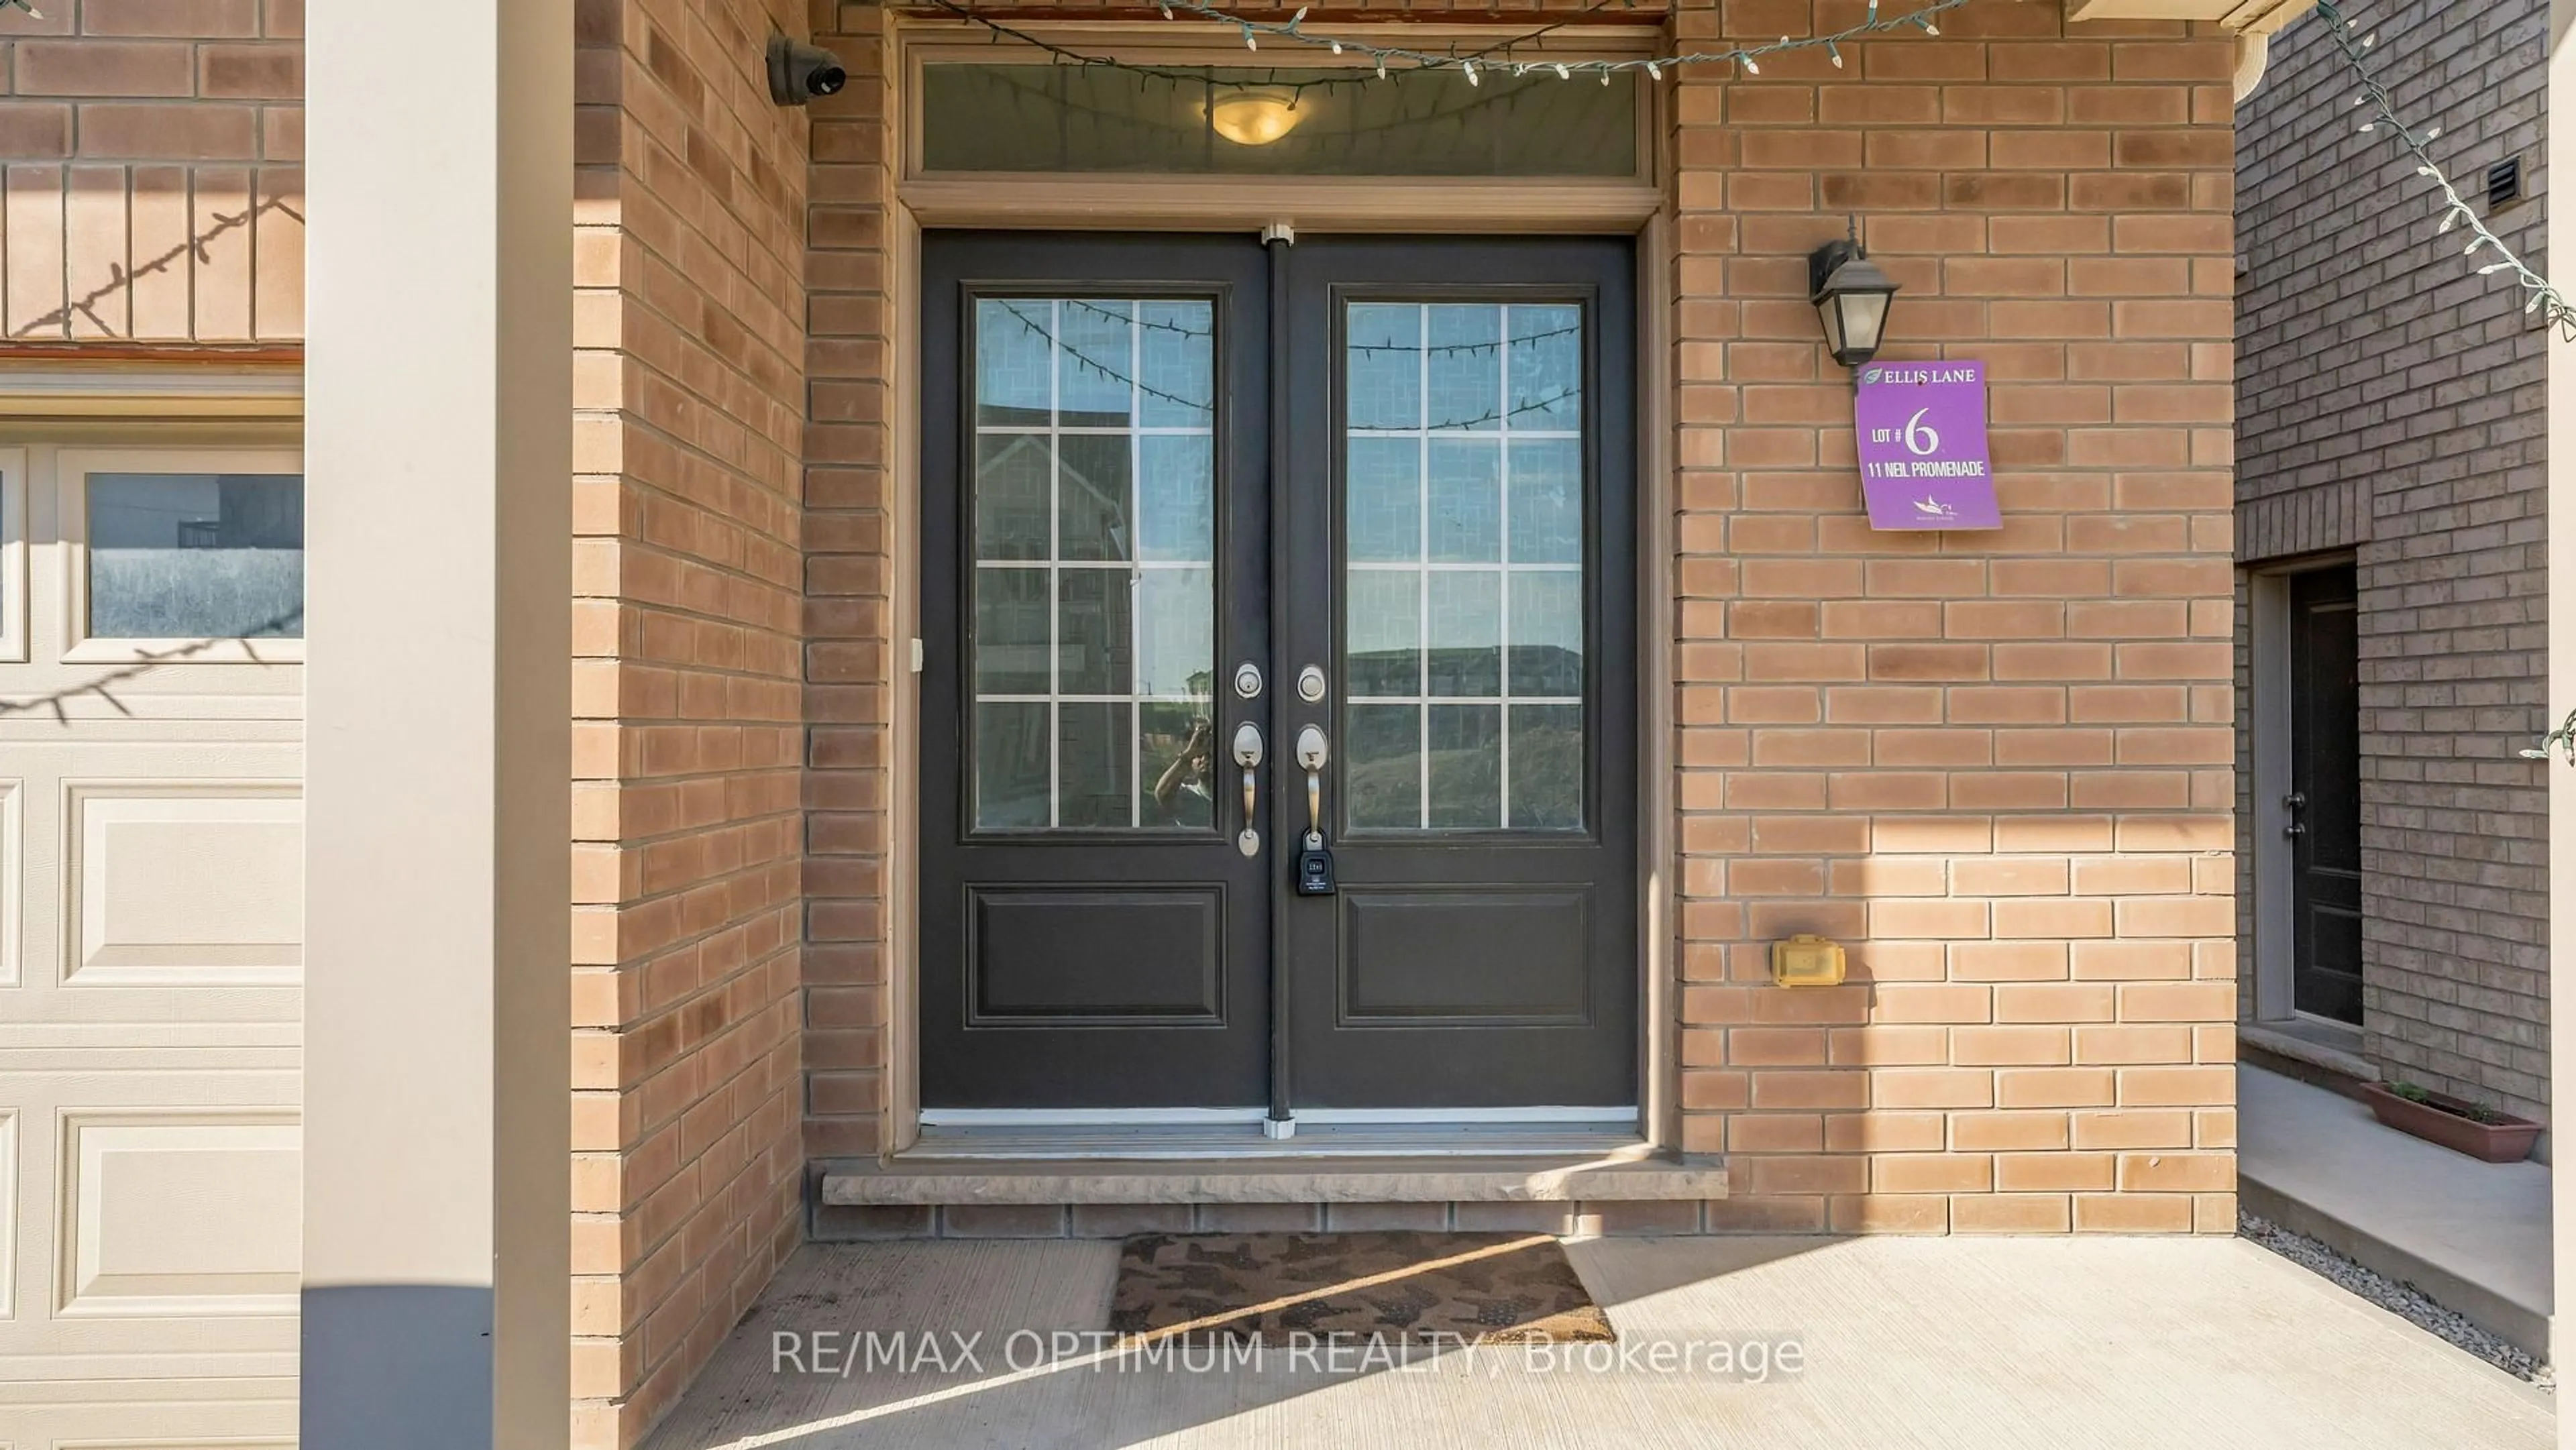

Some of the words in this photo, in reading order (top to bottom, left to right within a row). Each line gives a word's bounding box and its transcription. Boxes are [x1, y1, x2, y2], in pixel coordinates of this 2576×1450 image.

[1884, 370, 1928, 384] ELLIS
[1931, 369, 1976, 383] LANE
[1872, 429, 1890, 443] LOT
[1868, 461, 1882, 478] 11
[1884, 461, 1911, 478] NEIL
[1912, 461, 1985, 478] PROMENADE
